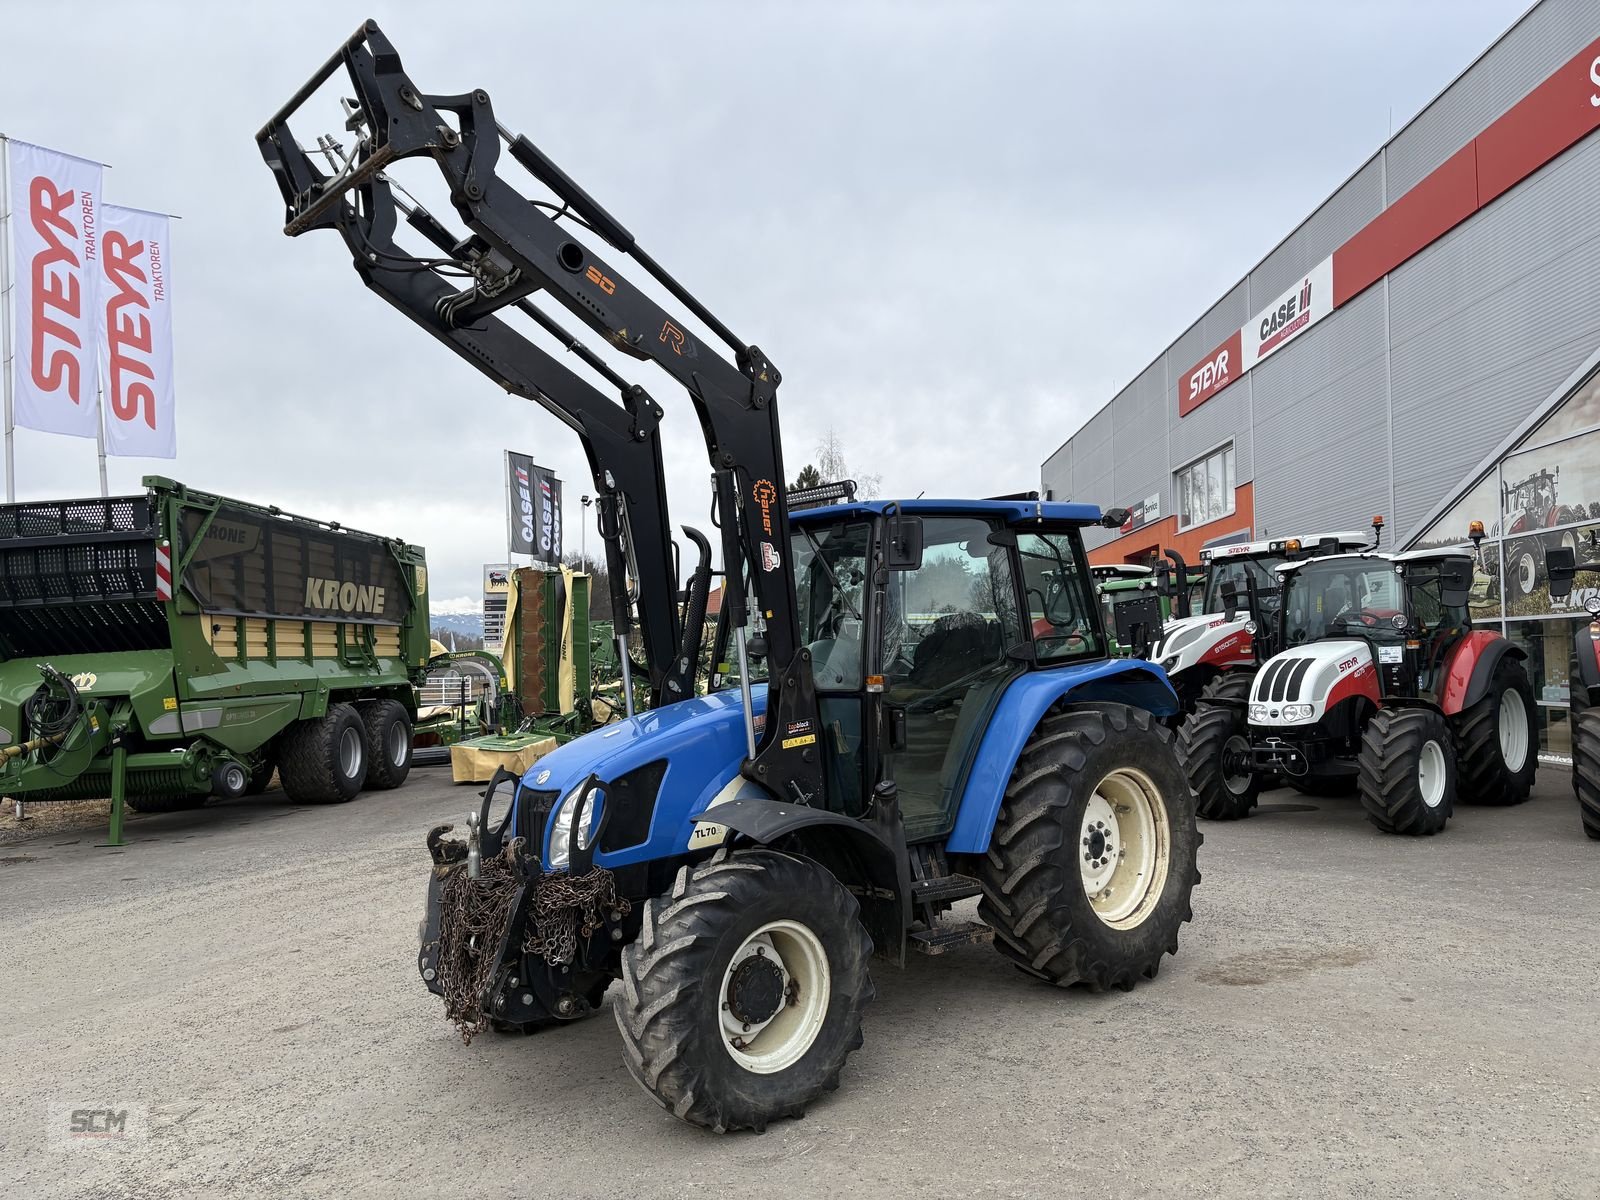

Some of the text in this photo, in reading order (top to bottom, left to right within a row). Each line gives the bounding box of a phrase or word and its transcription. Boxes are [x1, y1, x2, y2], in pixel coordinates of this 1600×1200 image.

[81, 191, 96, 261] TRAKTOREN
[29, 176, 81, 405] STEYR
[149, 241, 164, 302] TRAKTOREN
[102, 230, 156, 430] STEYR
[1260, 295, 1297, 341] CASE
[1189, 350, 1229, 401] STEYR
[520, 486, 534, 542] CASE
[541, 497, 552, 551] CASE
[1145, 501, 1158, 514] Service
[207, 525, 246, 543] RONE
[1227, 546, 1250, 554] STEYR
[304, 577, 385, 614] KRONE
[1339, 657, 1359, 673] STEYR
